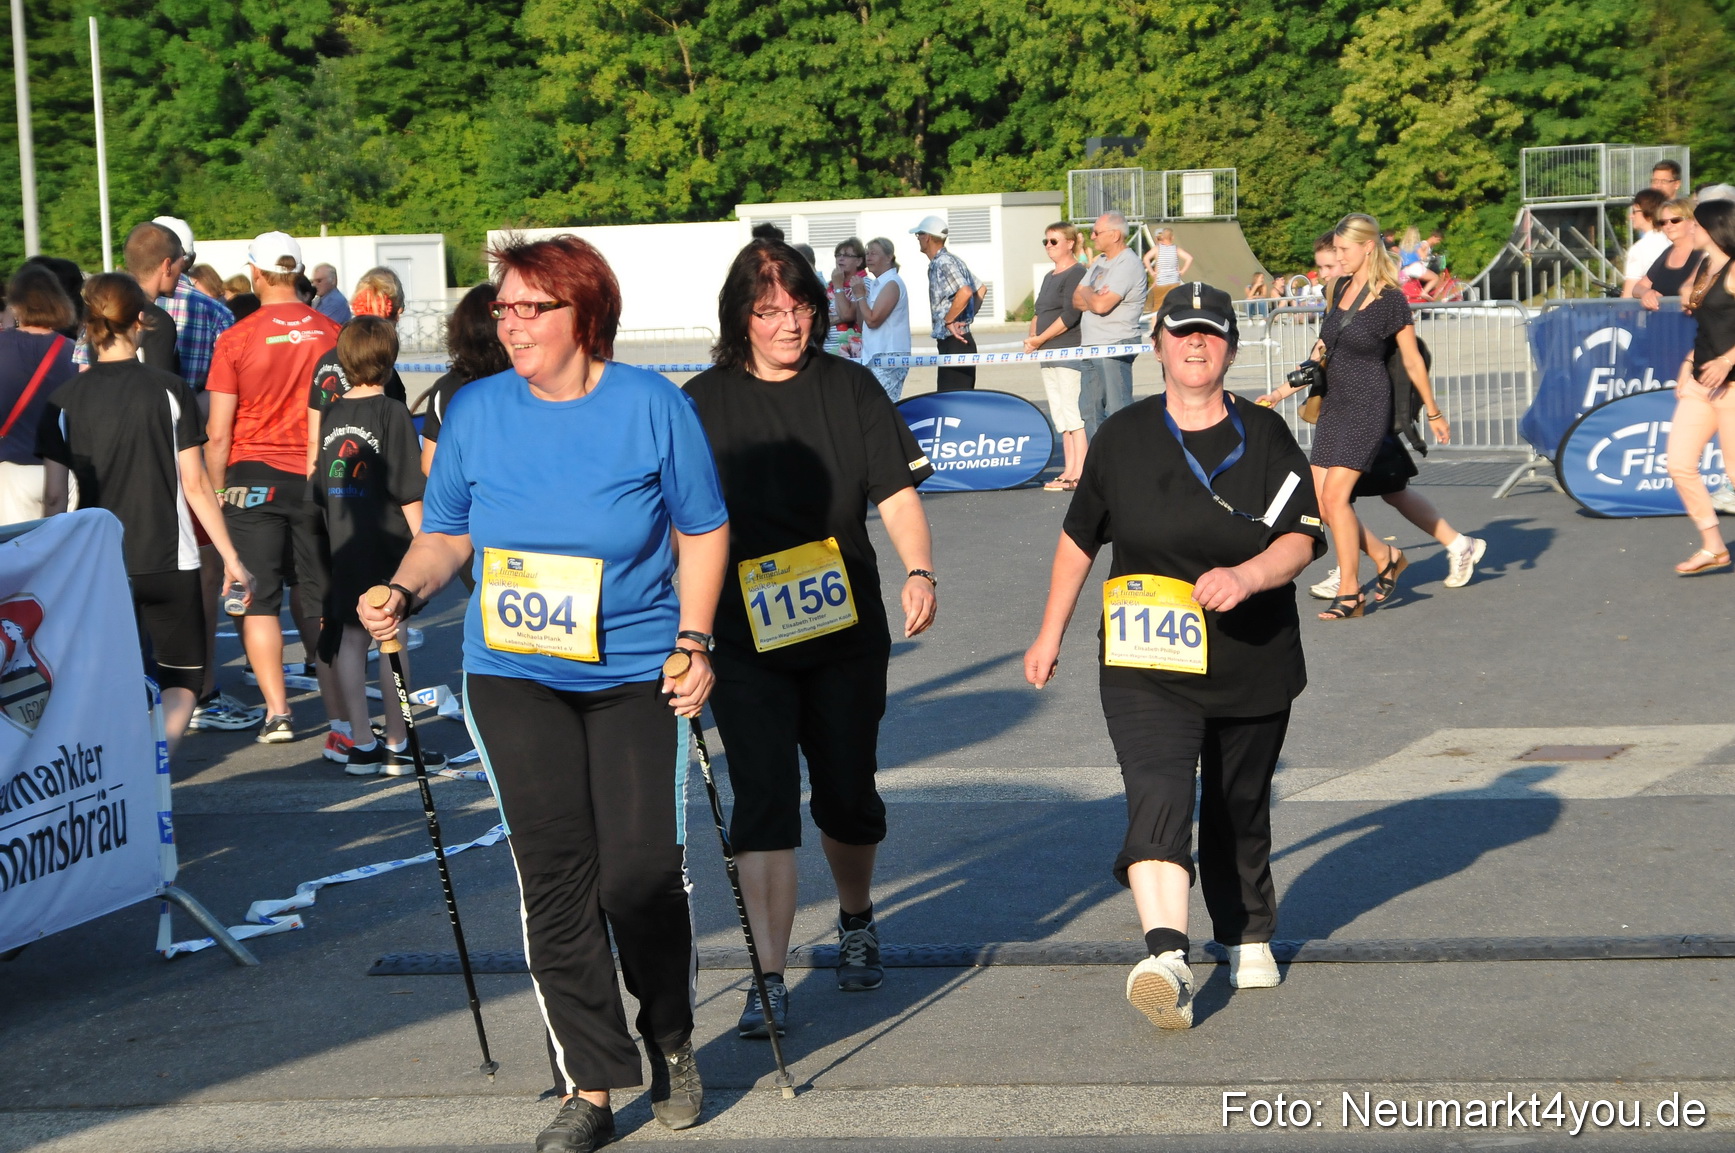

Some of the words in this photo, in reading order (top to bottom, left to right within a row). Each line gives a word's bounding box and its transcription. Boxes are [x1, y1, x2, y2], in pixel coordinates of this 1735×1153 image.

[917, 433, 1030, 459] Fischer
[930, 455, 1021, 471] AUTOMOBILE
[497, 589, 577, 635] 694
[750, 570, 847, 627] 1156
[517, 632, 542, 640] Michaela
[782, 618, 808, 630] Elisabeth
[1110, 606, 1202, 649] 1146
[391, 671, 402, 689] FOR
[397, 687, 413, 724] SPORT
